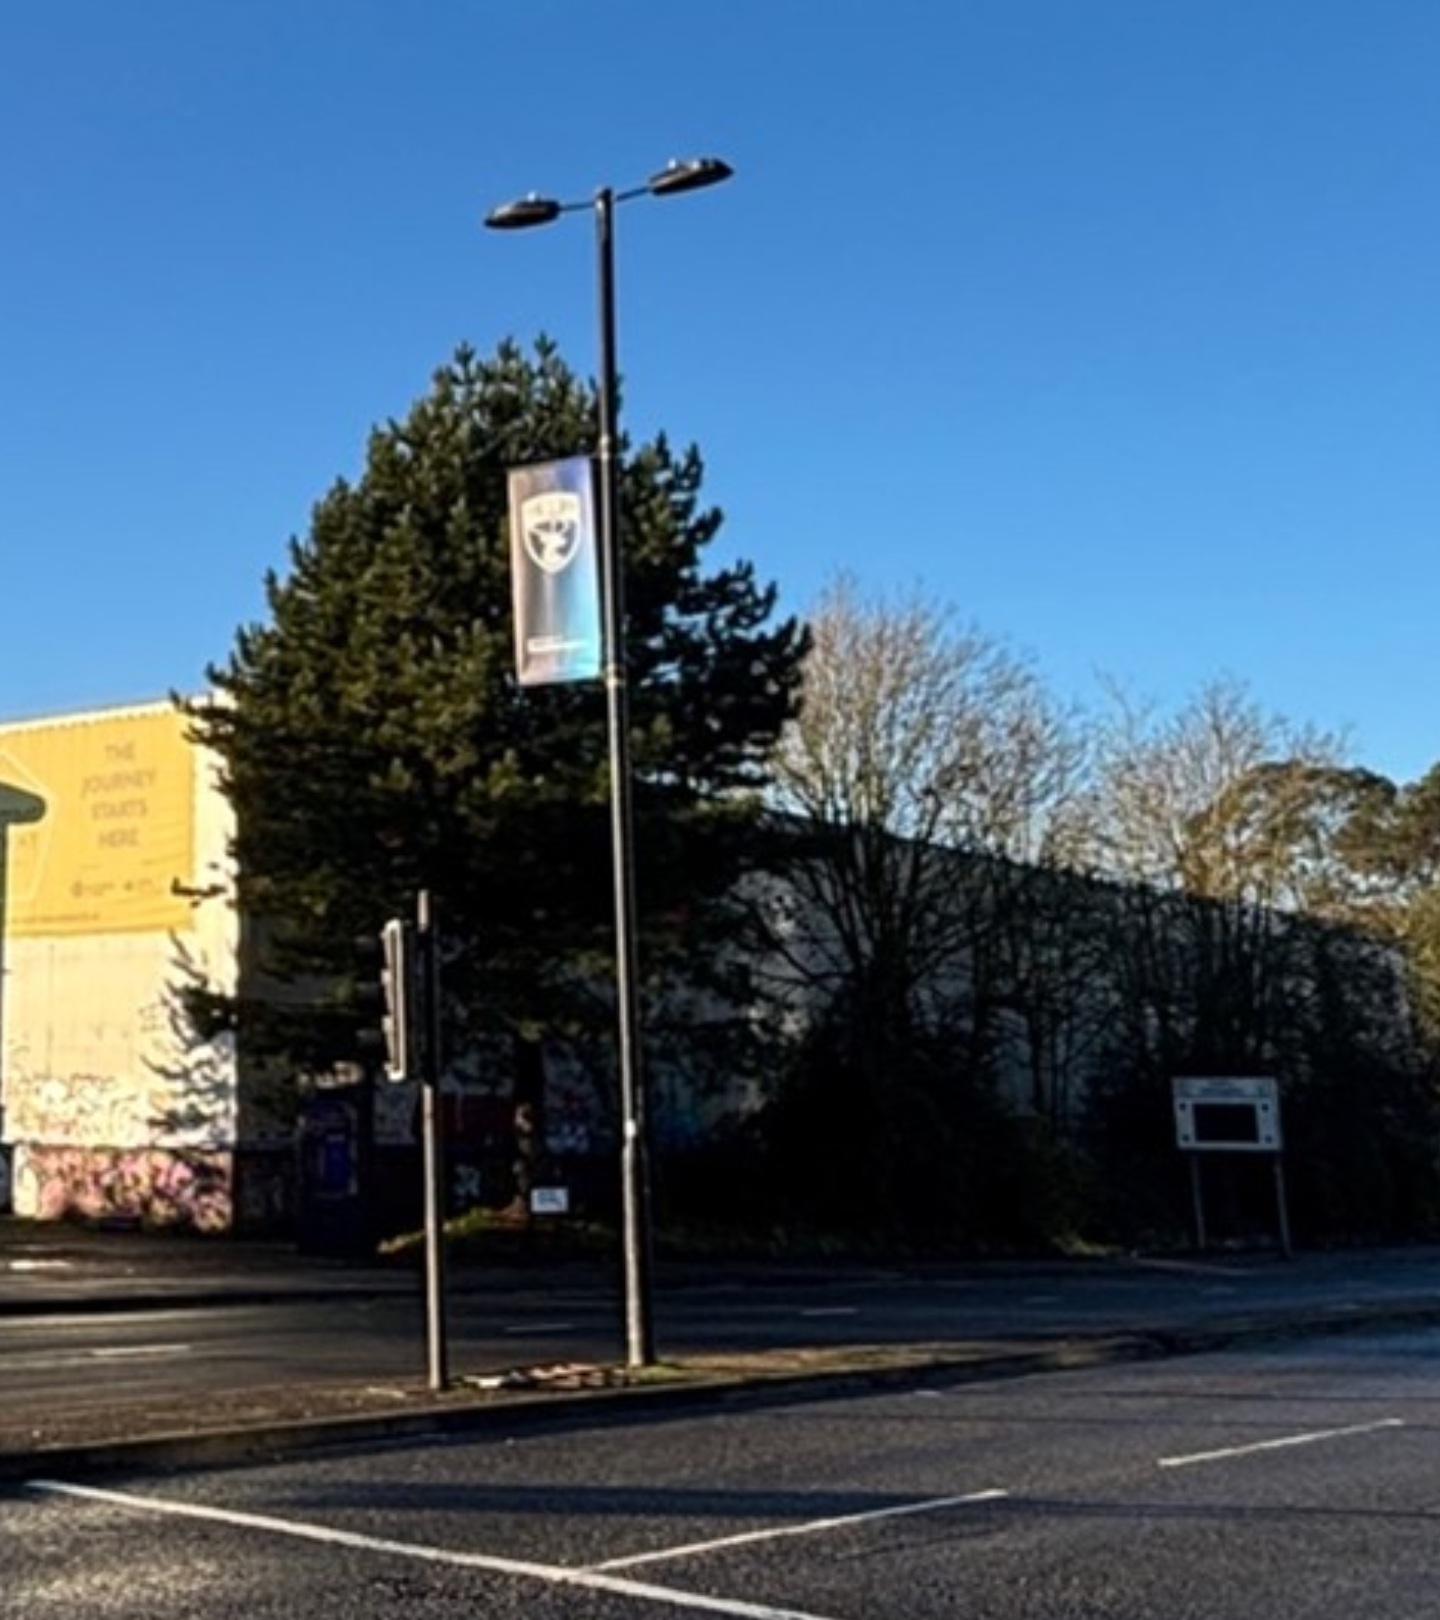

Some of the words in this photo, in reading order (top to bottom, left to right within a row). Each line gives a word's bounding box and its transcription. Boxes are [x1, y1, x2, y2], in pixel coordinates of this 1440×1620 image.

[104, 741, 136, 762] THE
[81, 767, 157, 798] JOURNEY
[91, 799, 149, 822] STARTS
[98, 828, 139, 850] HERE
